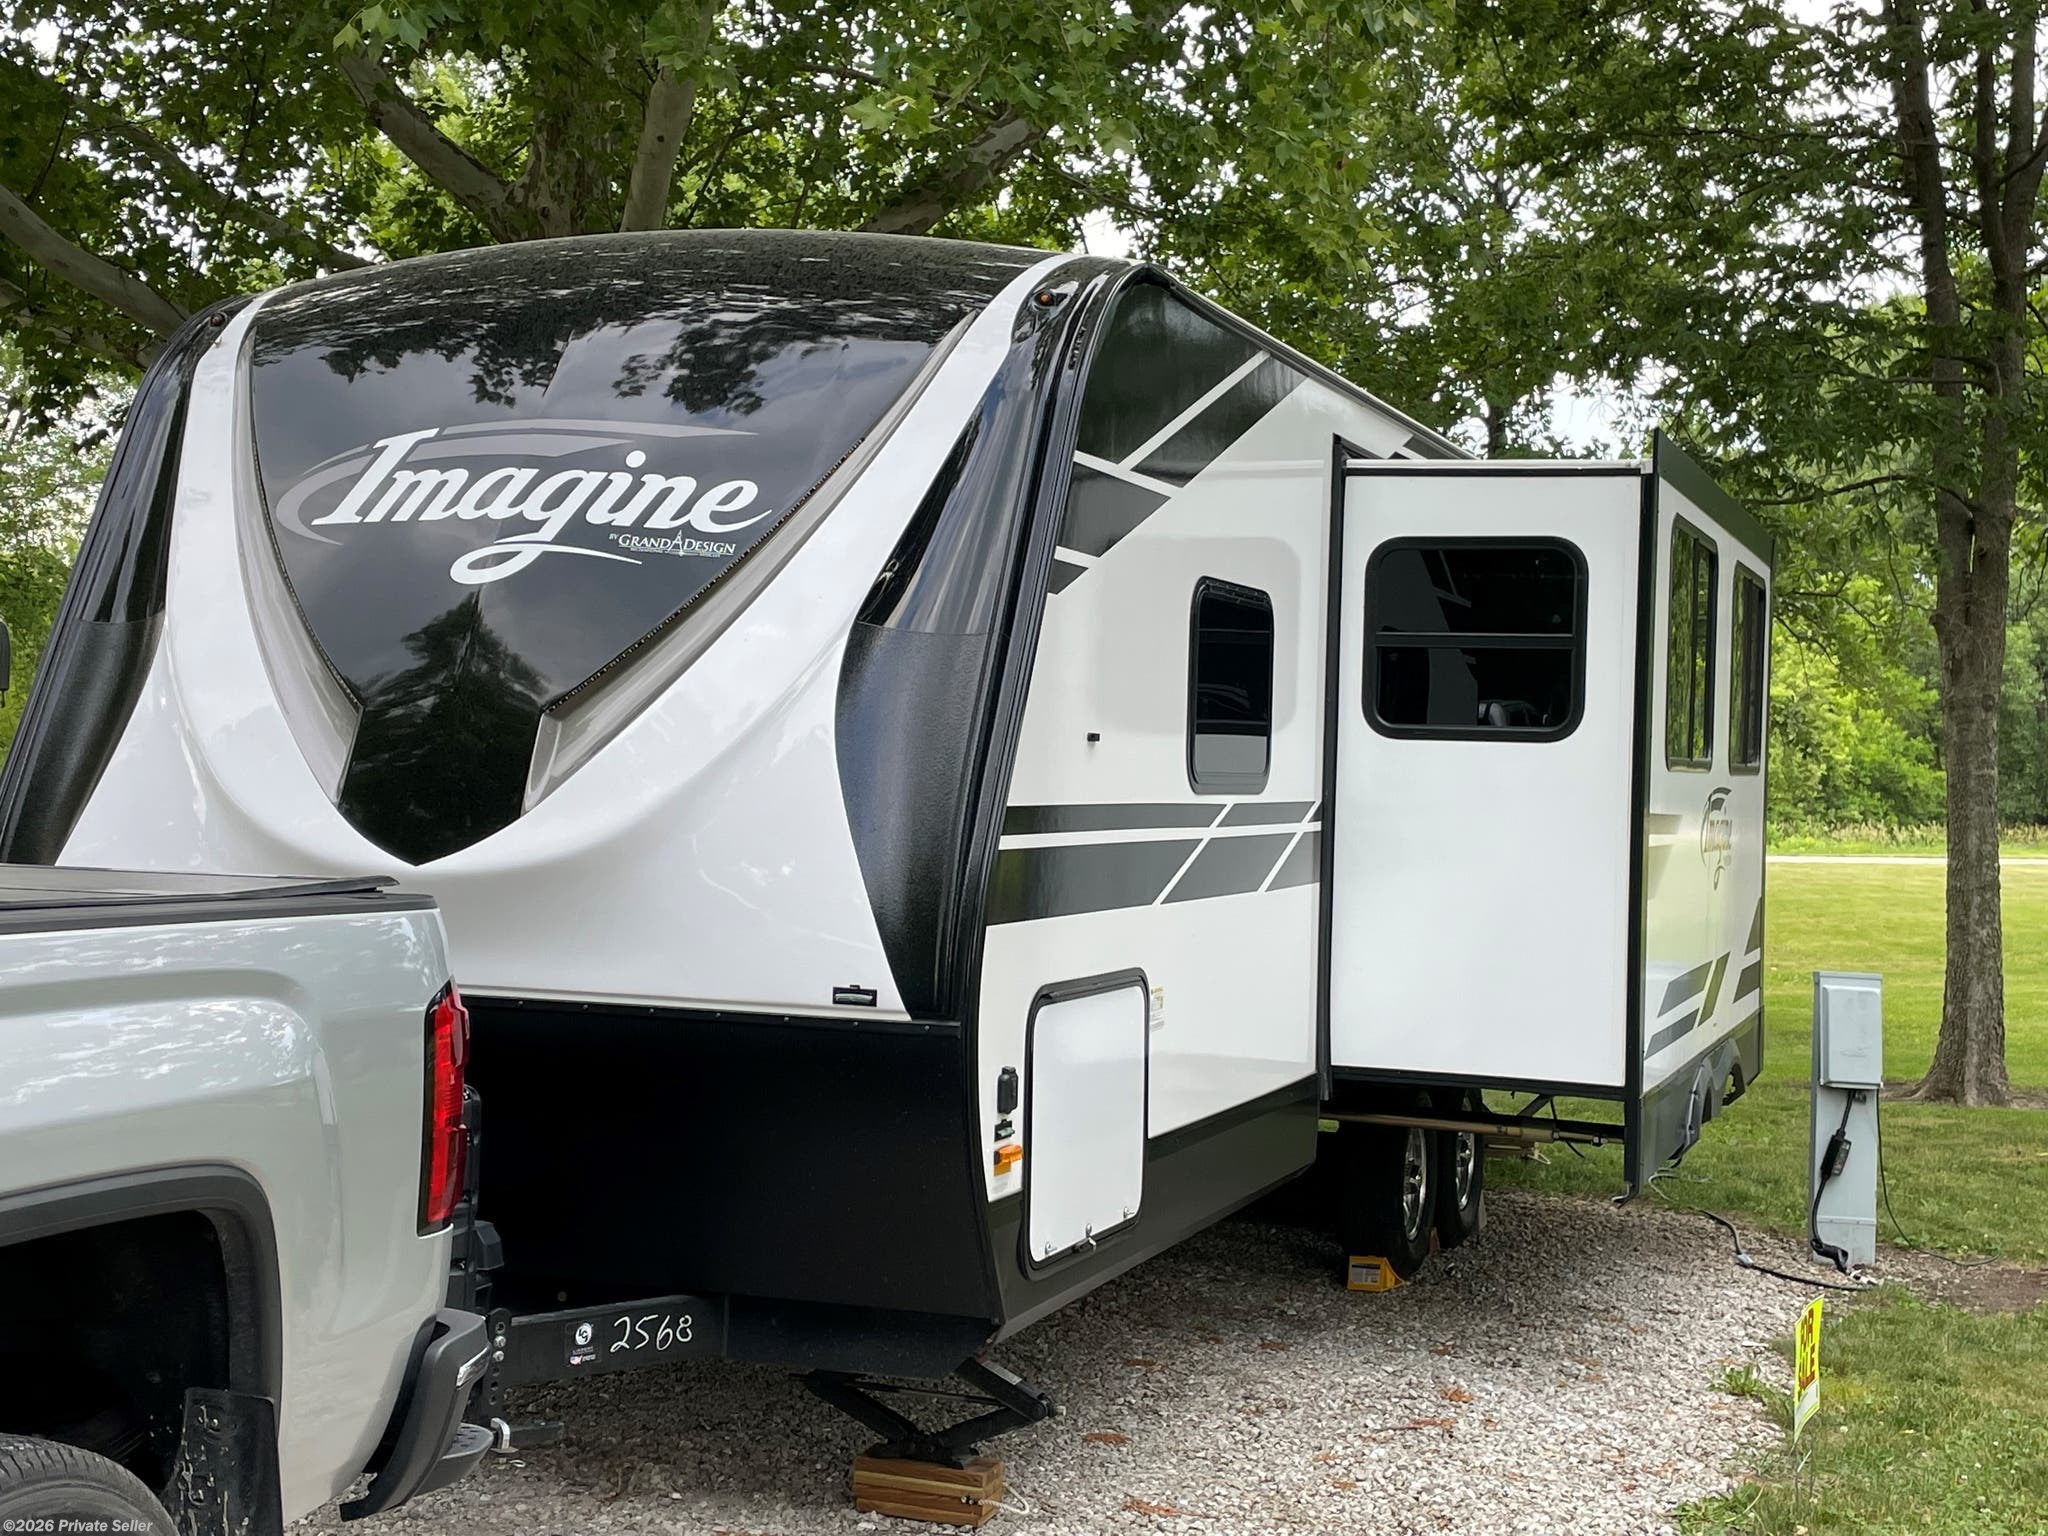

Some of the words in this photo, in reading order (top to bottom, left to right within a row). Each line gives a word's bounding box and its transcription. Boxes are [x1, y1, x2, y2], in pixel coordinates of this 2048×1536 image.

[311, 428, 772, 585] Imagine
[619, 533, 673, 551] GRAND
[683, 538, 736, 555] DESIGN
[610, 1314, 693, 1352] 2568
